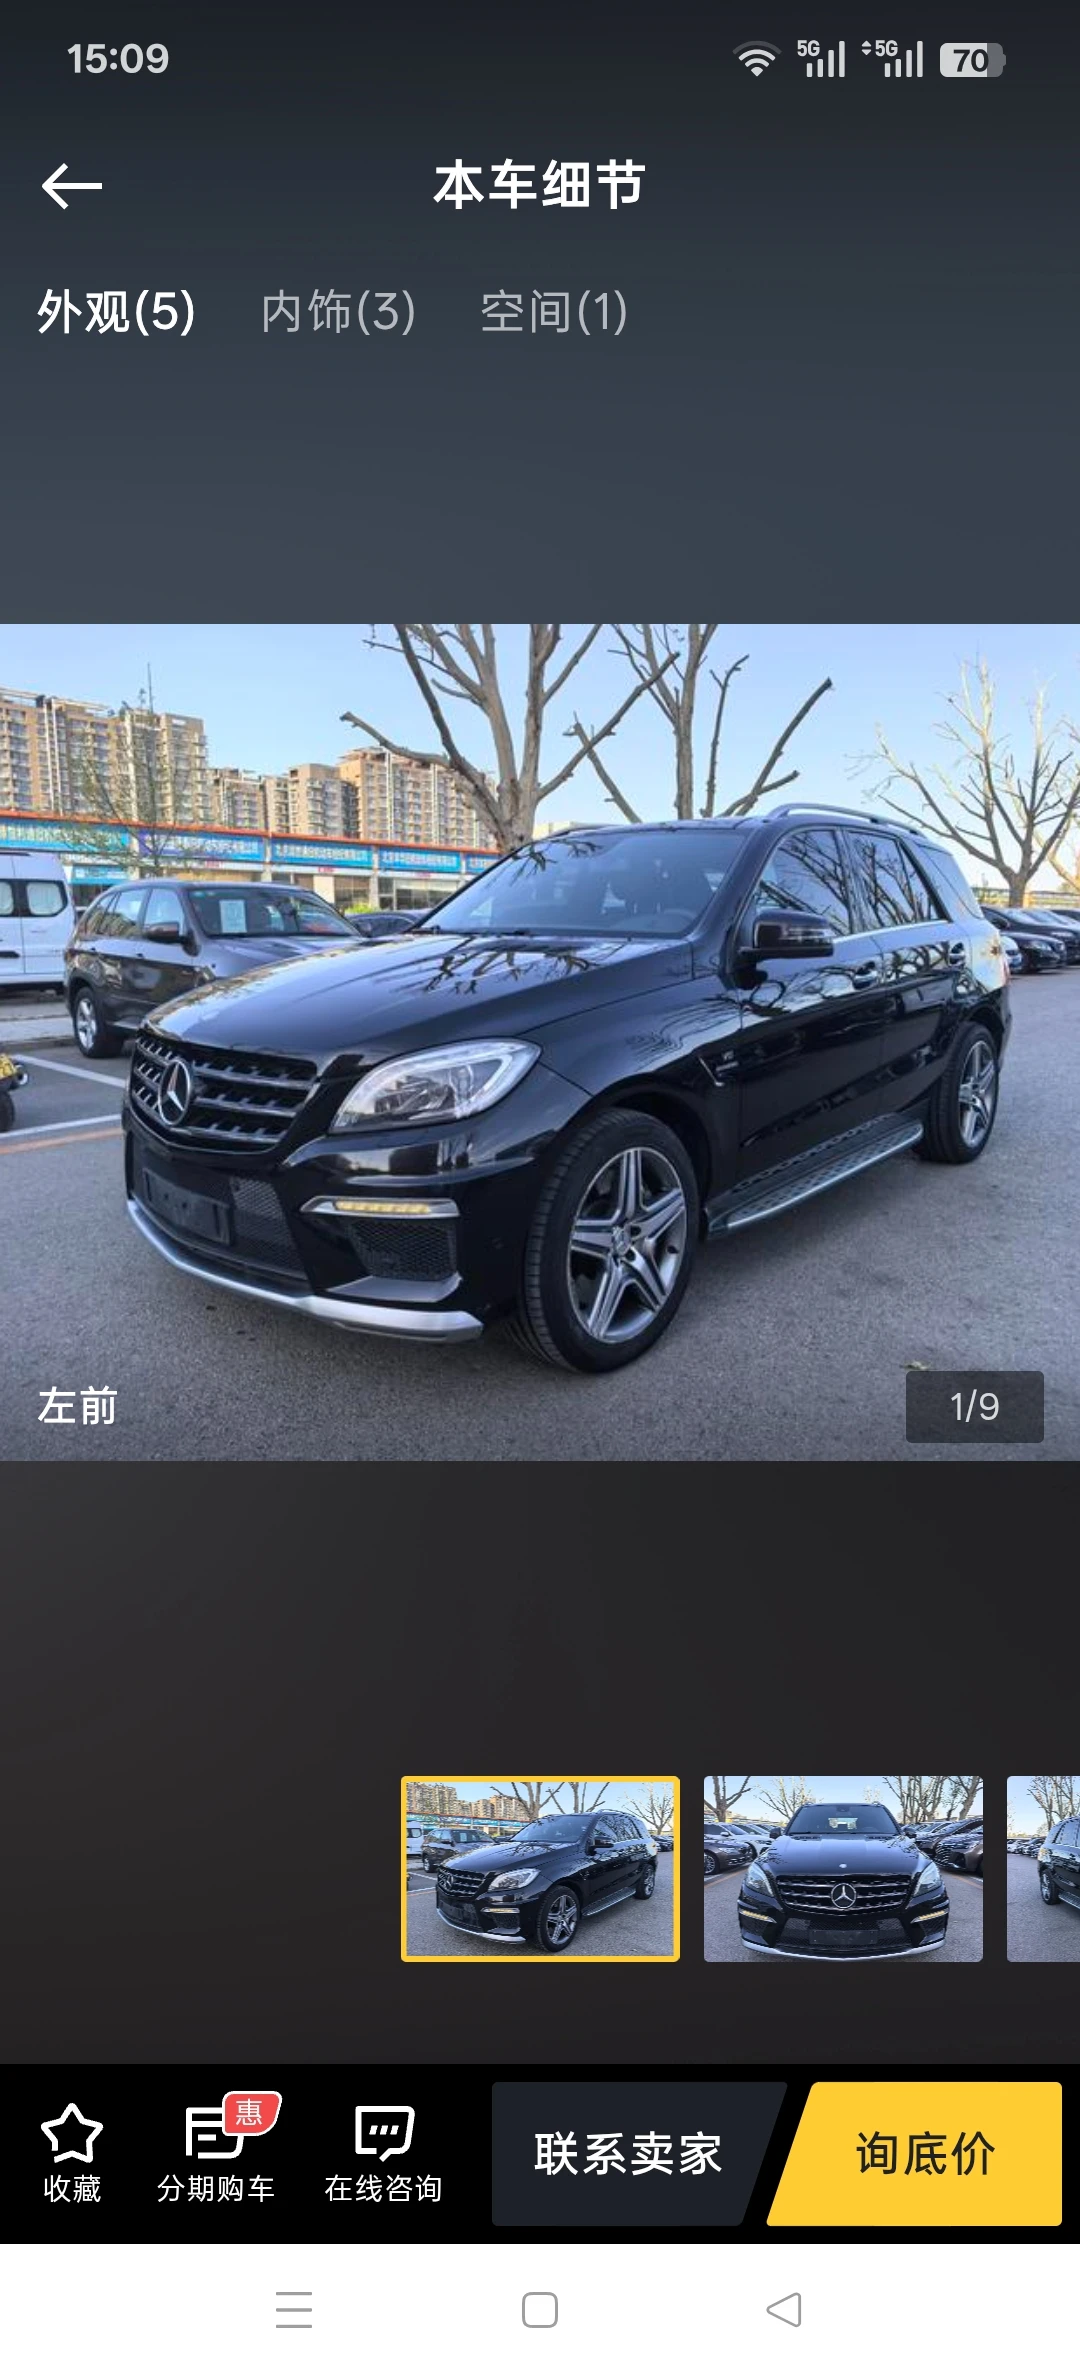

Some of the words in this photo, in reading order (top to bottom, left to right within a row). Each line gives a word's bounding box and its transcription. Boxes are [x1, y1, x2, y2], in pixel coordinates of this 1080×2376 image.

[68, 44, 169, 73] 15:09
[797, 40, 821, 57] 5G
[875, 40, 899, 57] 5G
[953, 49, 989, 72] 70
[433, 158, 646, 210] 本车细节
[37, 288, 195, 337] 外观(5)
[263, 288, 415, 336] 内饰(3)
[481, 288, 627, 336] 空间(1)
[236, 2098, 263, 2126] 惠
[534, 2130, 723, 2176] 联系卖家
[856, 2130, 996, 2176] 询底价
[43, 2174, 102, 2204] 收藏
[157, 2173, 275, 2203] 分期购车
[324, 2173, 442, 2203] 在线咨询
